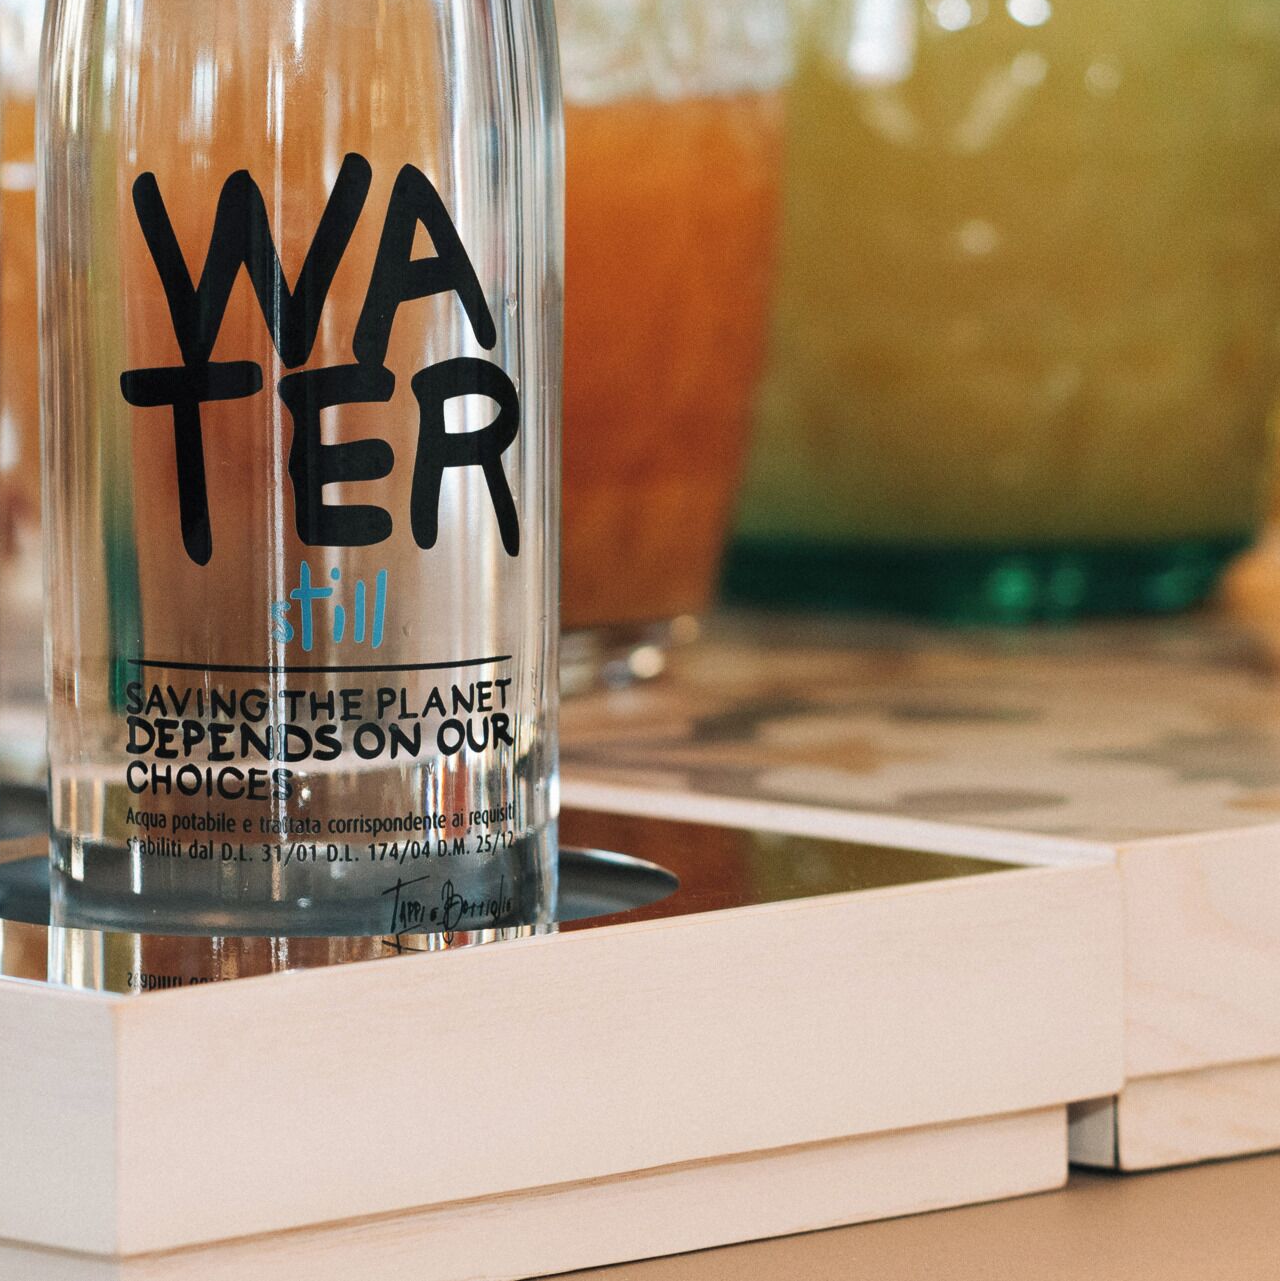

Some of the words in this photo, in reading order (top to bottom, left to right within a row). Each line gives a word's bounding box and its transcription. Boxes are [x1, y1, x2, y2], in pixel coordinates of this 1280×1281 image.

[132, 152, 497, 368] WA
[120, 356, 520, 566] TER
[271, 560, 388, 652] still
[125, 681, 269, 723] SAVING
[278, 688, 364, 722] THE
[376, 677, 513, 720] PLANET
[125, 715, 343, 763] DEPENDS
[353, 721, 422, 761] ON
[436, 712, 515, 757] OUR
[125, 759, 294, 801] CHOICES
[125, 806, 167, 832] Acqua
[171, 812, 237, 834] potabile
[242, 816, 253, 834] e
[259, 814, 322, 835] trattata
[327, 811, 447, 838] corrispondente
[451, 808, 464, 828] ai
[468, 799, 515, 829] requisiti
[188, 839, 214, 861] dal
[221, 843, 253, 862] D.L.
[261, 843, 317, 869] 31/01
[326, 843, 360, 862] D.L.
[367, 838, 431, 865] 174/04
[436, 837, 471, 857] D.M.
[476, 829, 515, 857] 25/12
